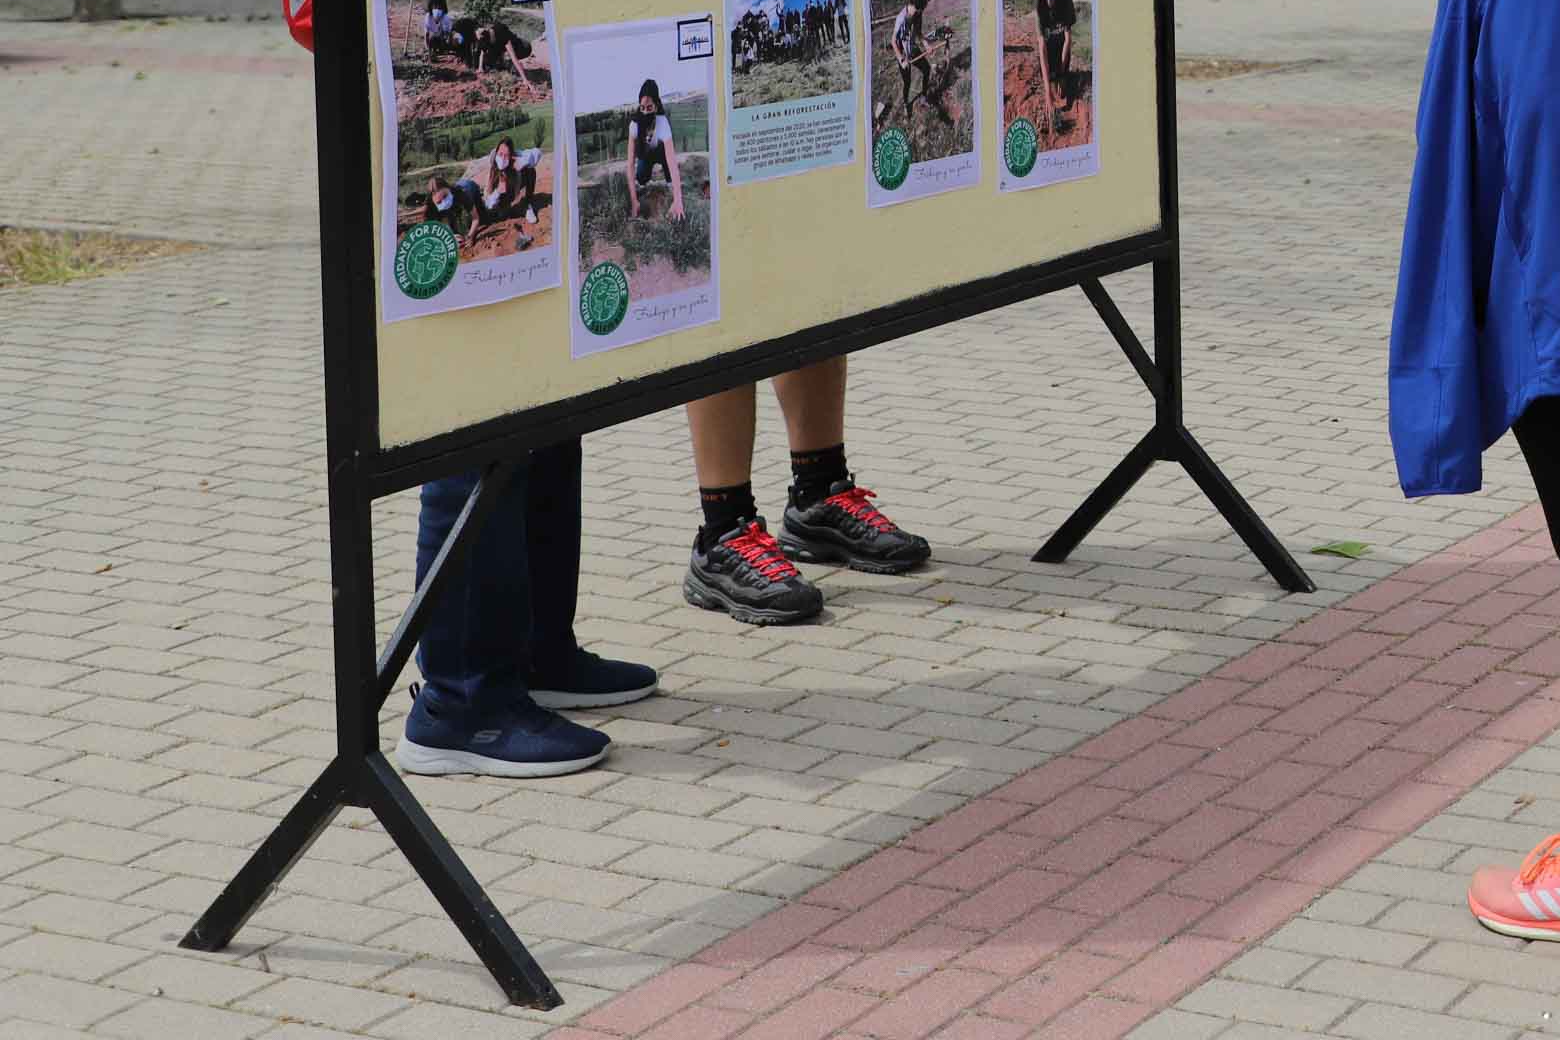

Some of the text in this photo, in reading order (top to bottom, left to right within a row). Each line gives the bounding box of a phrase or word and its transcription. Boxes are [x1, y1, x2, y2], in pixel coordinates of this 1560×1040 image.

[751, 101, 836, 122] LA GRAN REFORESTACIÓN
[874, 143, 883, 181] FRIDAYS
[881, 130, 893, 142] FOR
[893, 130, 909, 157] FUTURE
[396, 241, 411, 289] FRIDAYS
[409, 225, 430, 241] FOR
[431, 225, 457, 257] FUTURE
[581, 283, 593, 326] FRIDAYS
[591, 266, 605, 281] FOR
[607, 266, 627, 296] FUTURE
